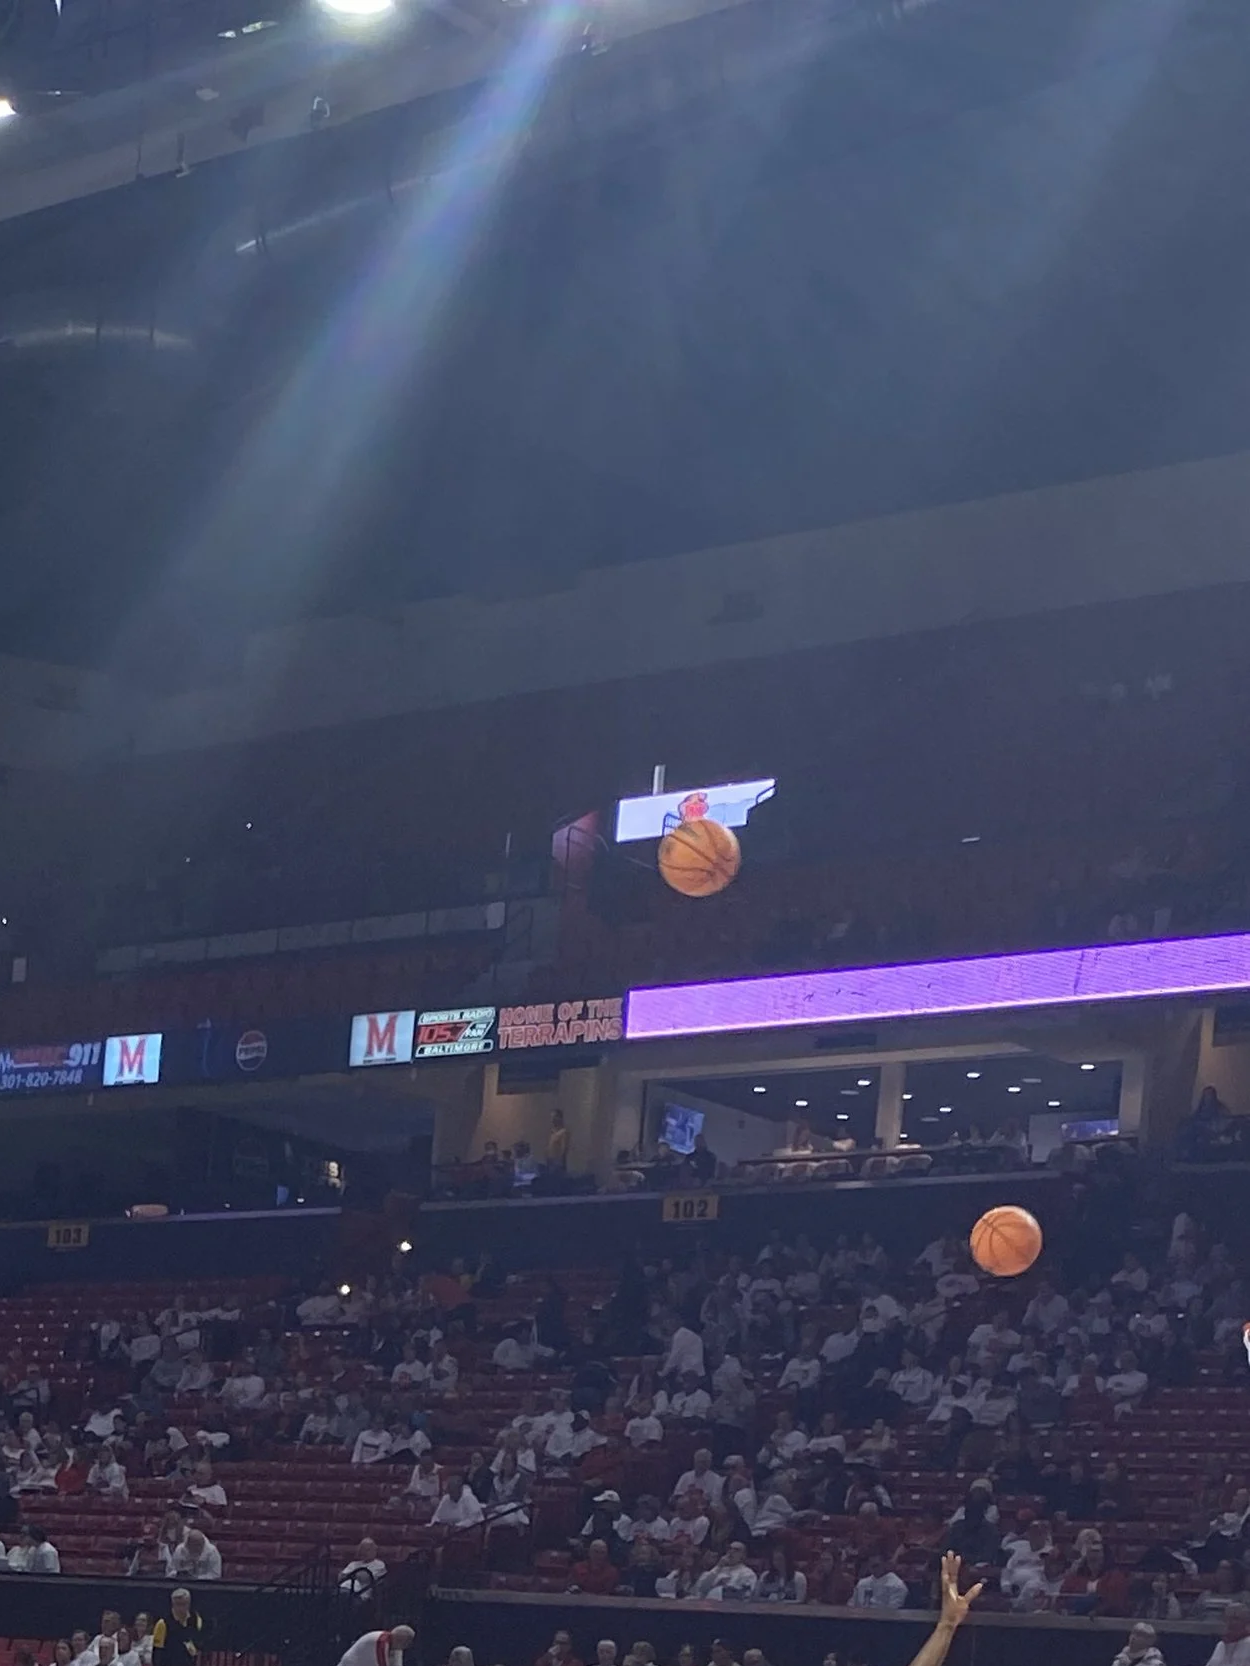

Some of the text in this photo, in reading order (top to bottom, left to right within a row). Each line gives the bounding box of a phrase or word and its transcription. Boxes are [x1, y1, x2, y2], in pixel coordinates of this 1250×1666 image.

[500, 998, 623, 1026] HOME OF THE
[366, 1014, 397, 1057] M
[498, 1018, 623, 1049] TERRAPINS
[68, 1042, 101, 1067] 911
[117, 1039, 146, 1077] M
[424, 1042, 485, 1054] BALTIMORE
[671, 1200, 708, 1218] 102
[56, 1228, 82, 1244] 103
